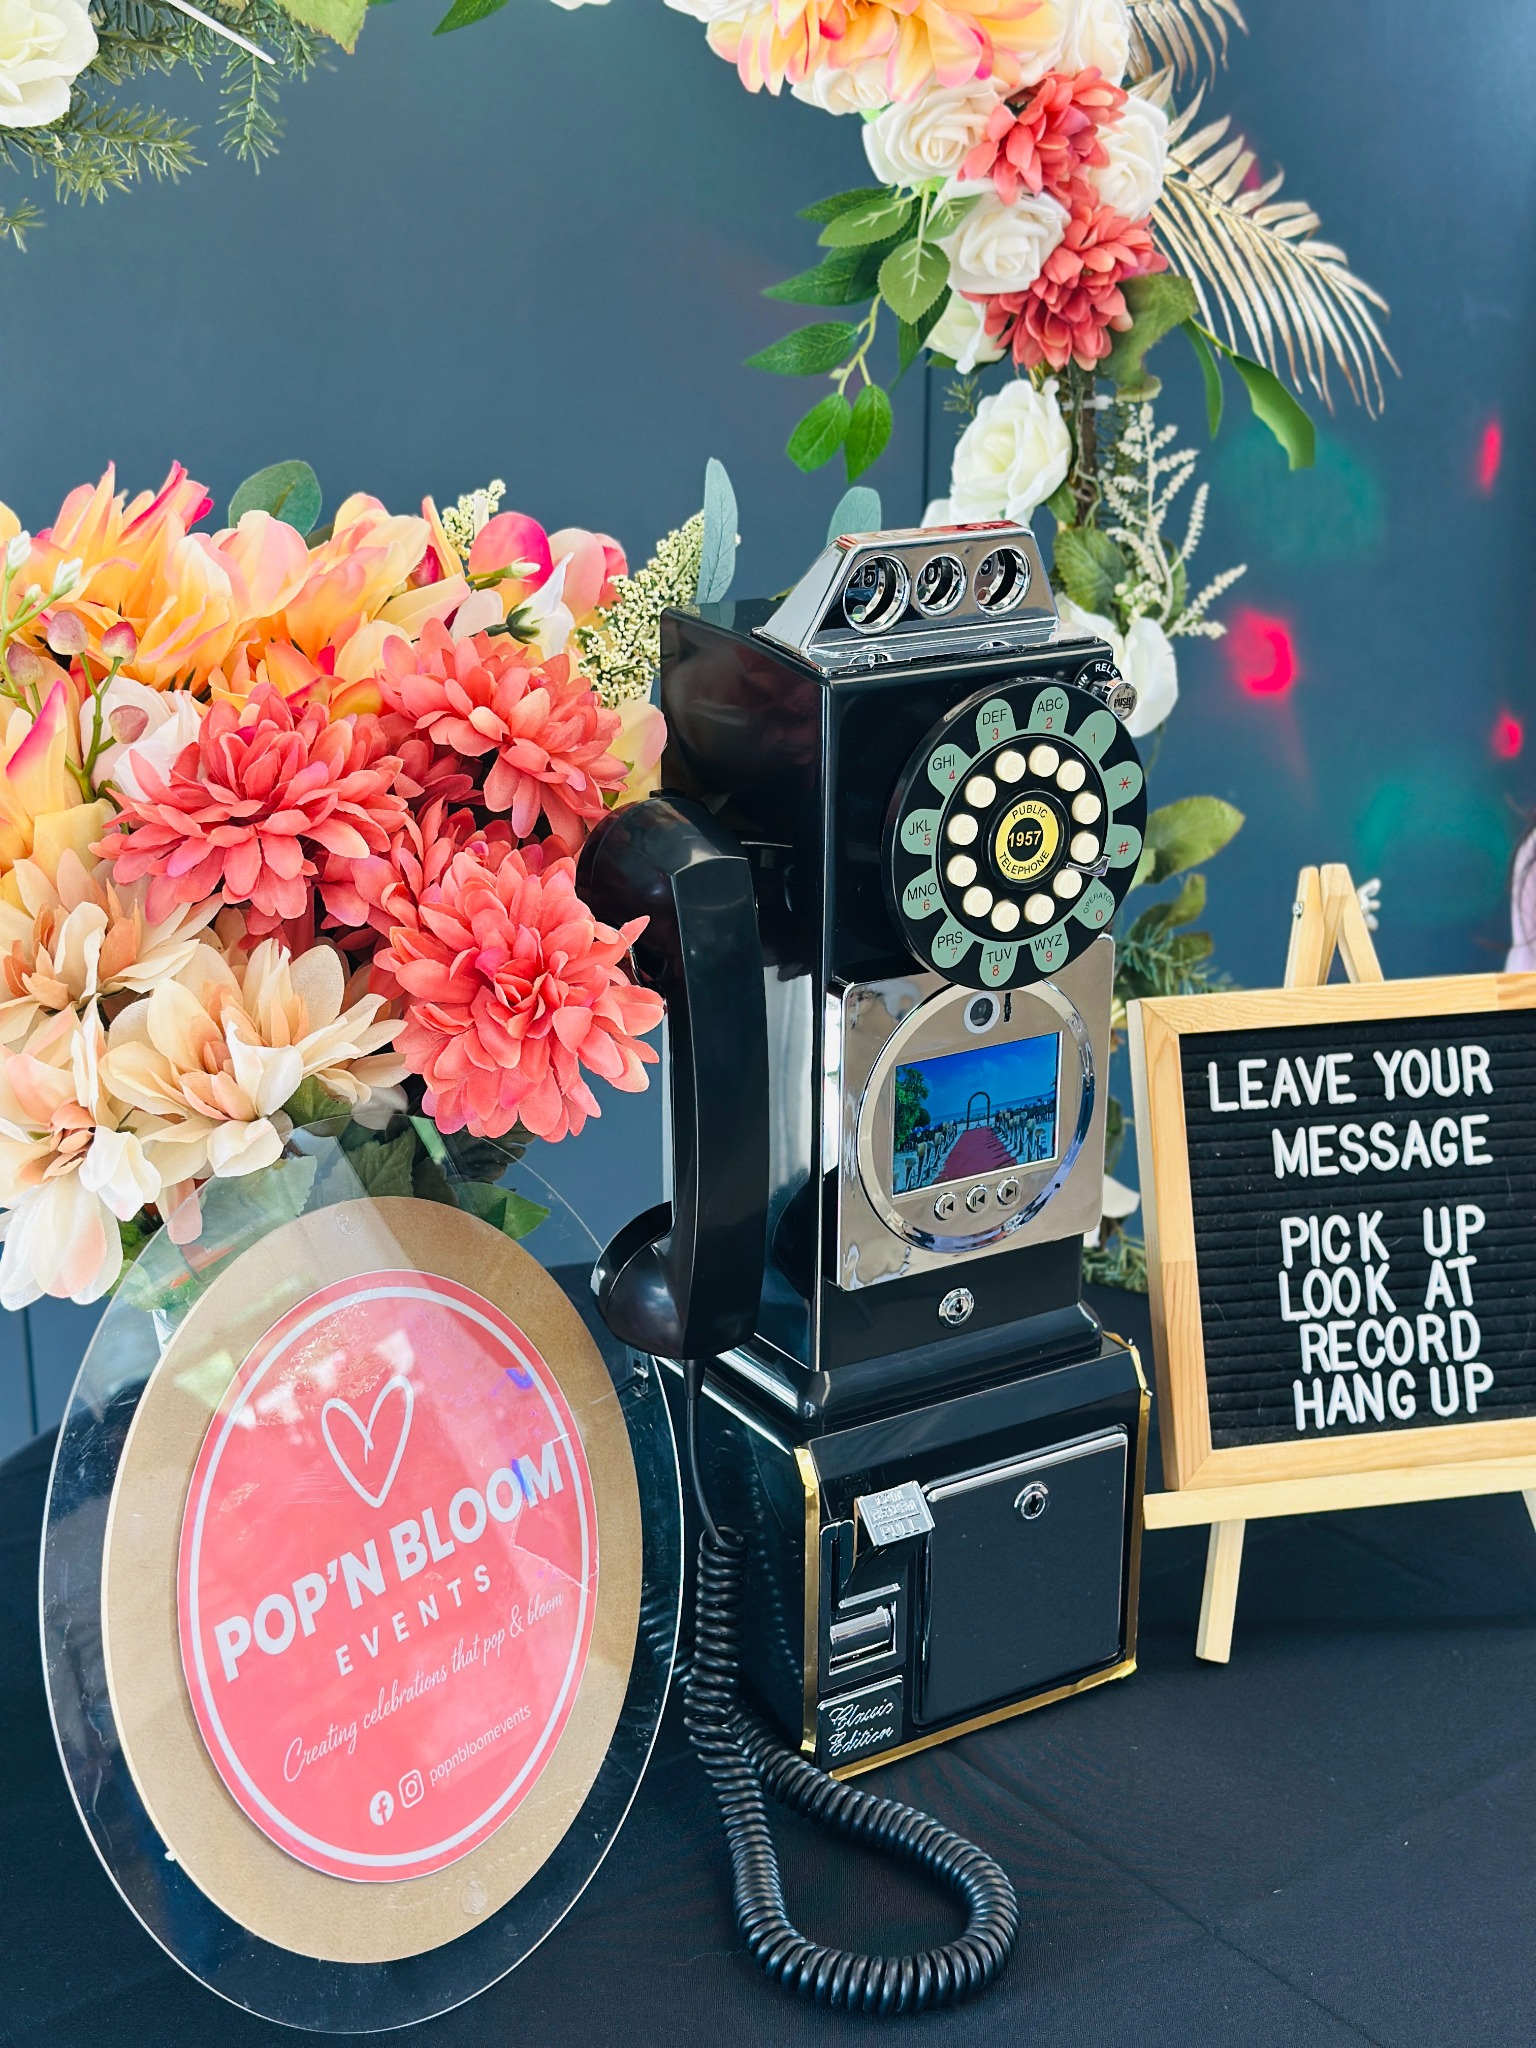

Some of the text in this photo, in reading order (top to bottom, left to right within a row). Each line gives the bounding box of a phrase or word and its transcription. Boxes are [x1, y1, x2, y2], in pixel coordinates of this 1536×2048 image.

[1095, 662, 1118, 678] RELE
[1036, 697, 1064, 714] ABC
[1113, 696, 1132, 708] PUSH
[982, 708, 1008, 726] DEF
[1045, 716, 1053, 730] 2
[991, 727, 999, 741] 3
[1091, 732, 1096, 744] 1
[932, 754, 955, 771] GHI
[948, 769, 956, 780] 4
[1011, 804, 1048, 820] PUBLIC
[909, 819, 932, 836] JKL
[923, 833, 931, 847] 5
[1008, 830, 1042, 848] 1957
[998, 849, 1050, 875] TELEPHONE
[907, 882, 938, 902] MNO
[923, 899, 931, 911] 6
[1082, 892, 1114, 914] OPERATOR
[1095, 909, 1104, 922] 0
[937, 931, 963, 949] PRS
[1034, 933, 1063, 952] WYZ
[950, 947, 958, 959] 7
[986, 946, 1012, 964] TUV
[1045, 950, 1053, 963] 9
[992, 964, 1000, 977] 8
[1207, 1045, 1493, 1112] LEAVE YOUR
[1271, 1114, 1493, 1179] MESSAGE
[1279, 1204, 1486, 1269] PICK UP
[1278, 1255, 1477, 1321] LOOK AT
[1300, 1310, 1481, 1374] RECORD
[1293, 1362, 1494, 1431] HANG UP
[879, 1517, 921, 1542] PULL
[213, 1442, 565, 1683] POP'N BLOOM
[335, 1564, 492, 1678] EVENTS
[283, 1590, 565, 1783] Creating celebrations that pop & bloom
[429, 1703, 532, 1787] popnbloomevents
[827, 1726, 894, 1757] Edition
